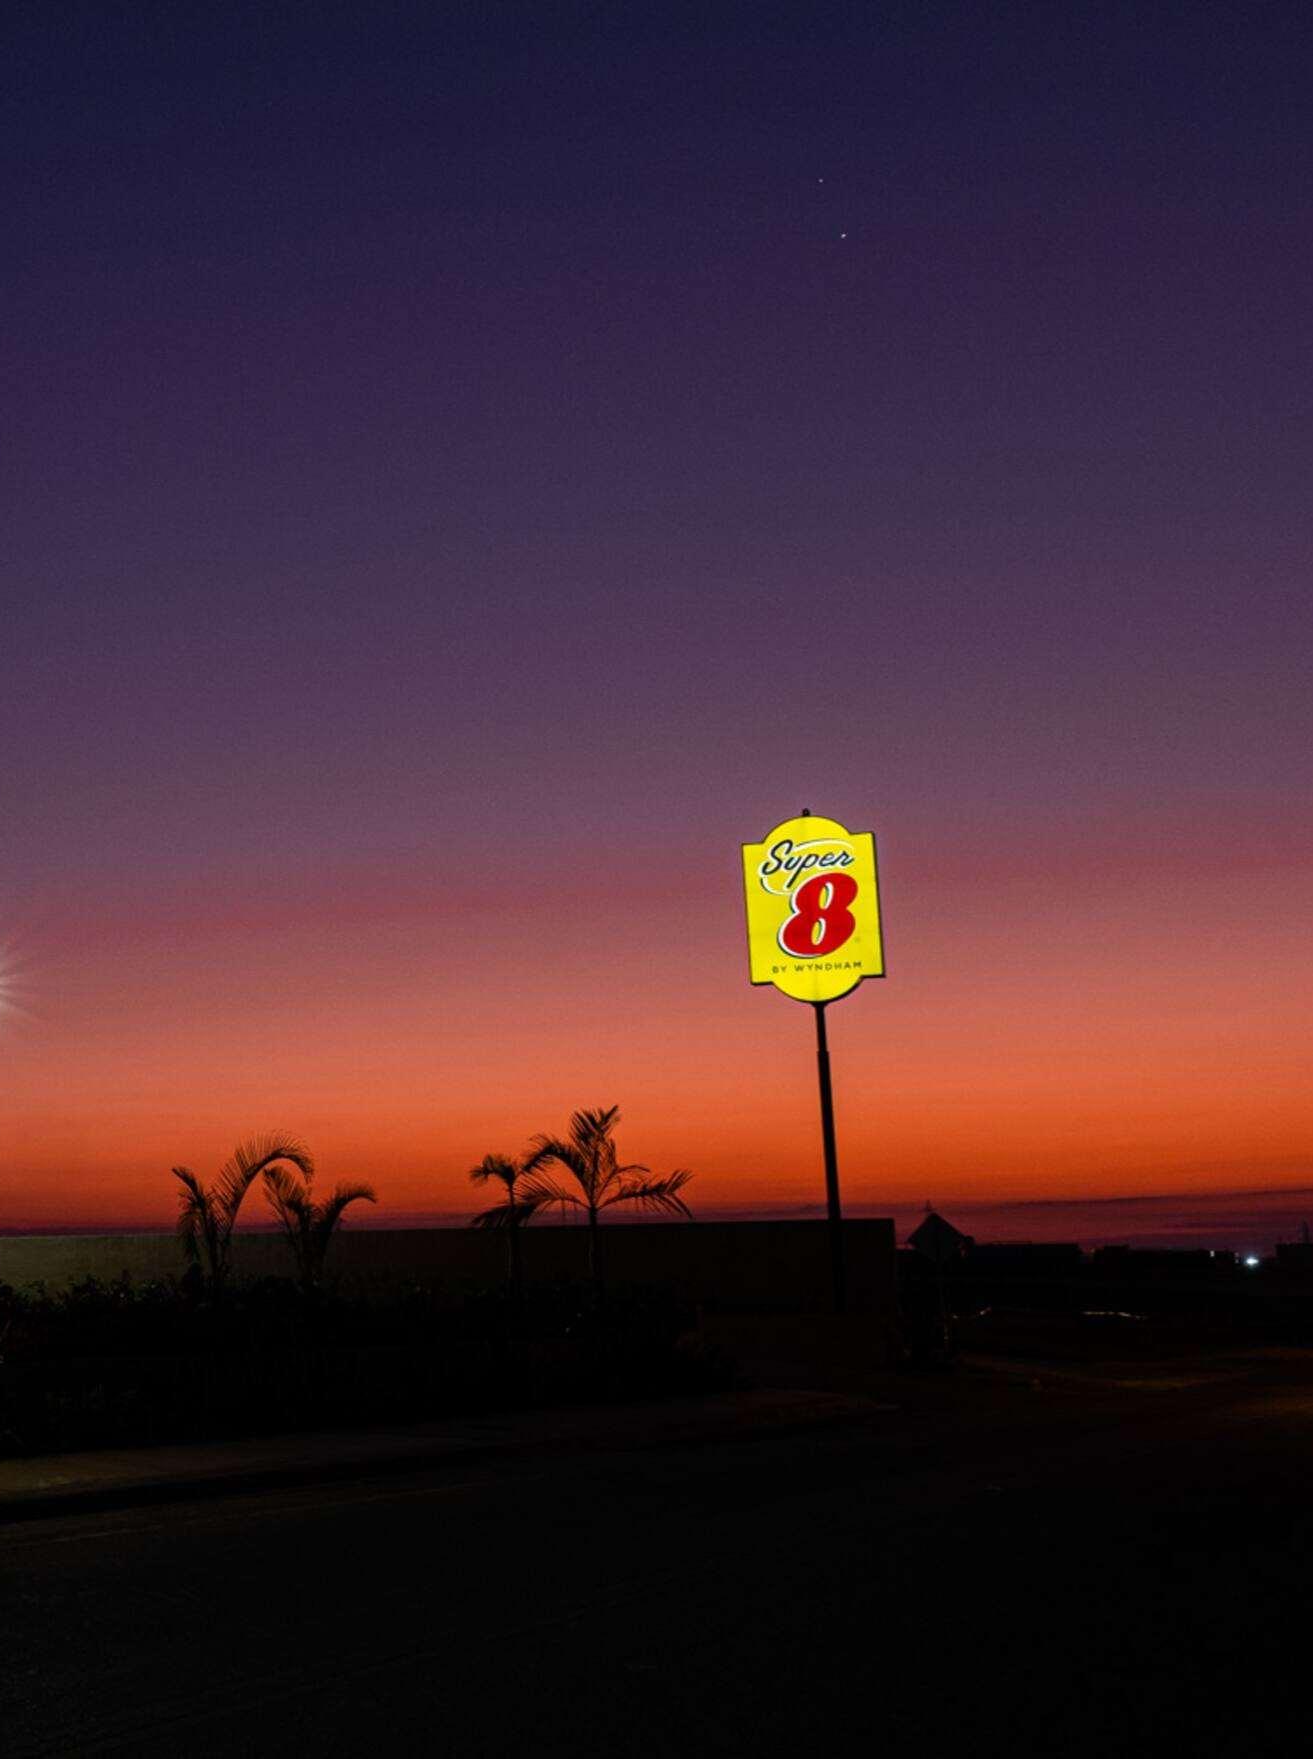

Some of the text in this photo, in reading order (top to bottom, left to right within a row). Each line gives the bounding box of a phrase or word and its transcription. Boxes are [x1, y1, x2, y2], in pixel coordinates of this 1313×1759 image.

[761, 839, 855, 889] Super
[777, 872, 859, 960] 8
[772, 960, 864, 974] BY WYNDHAM
